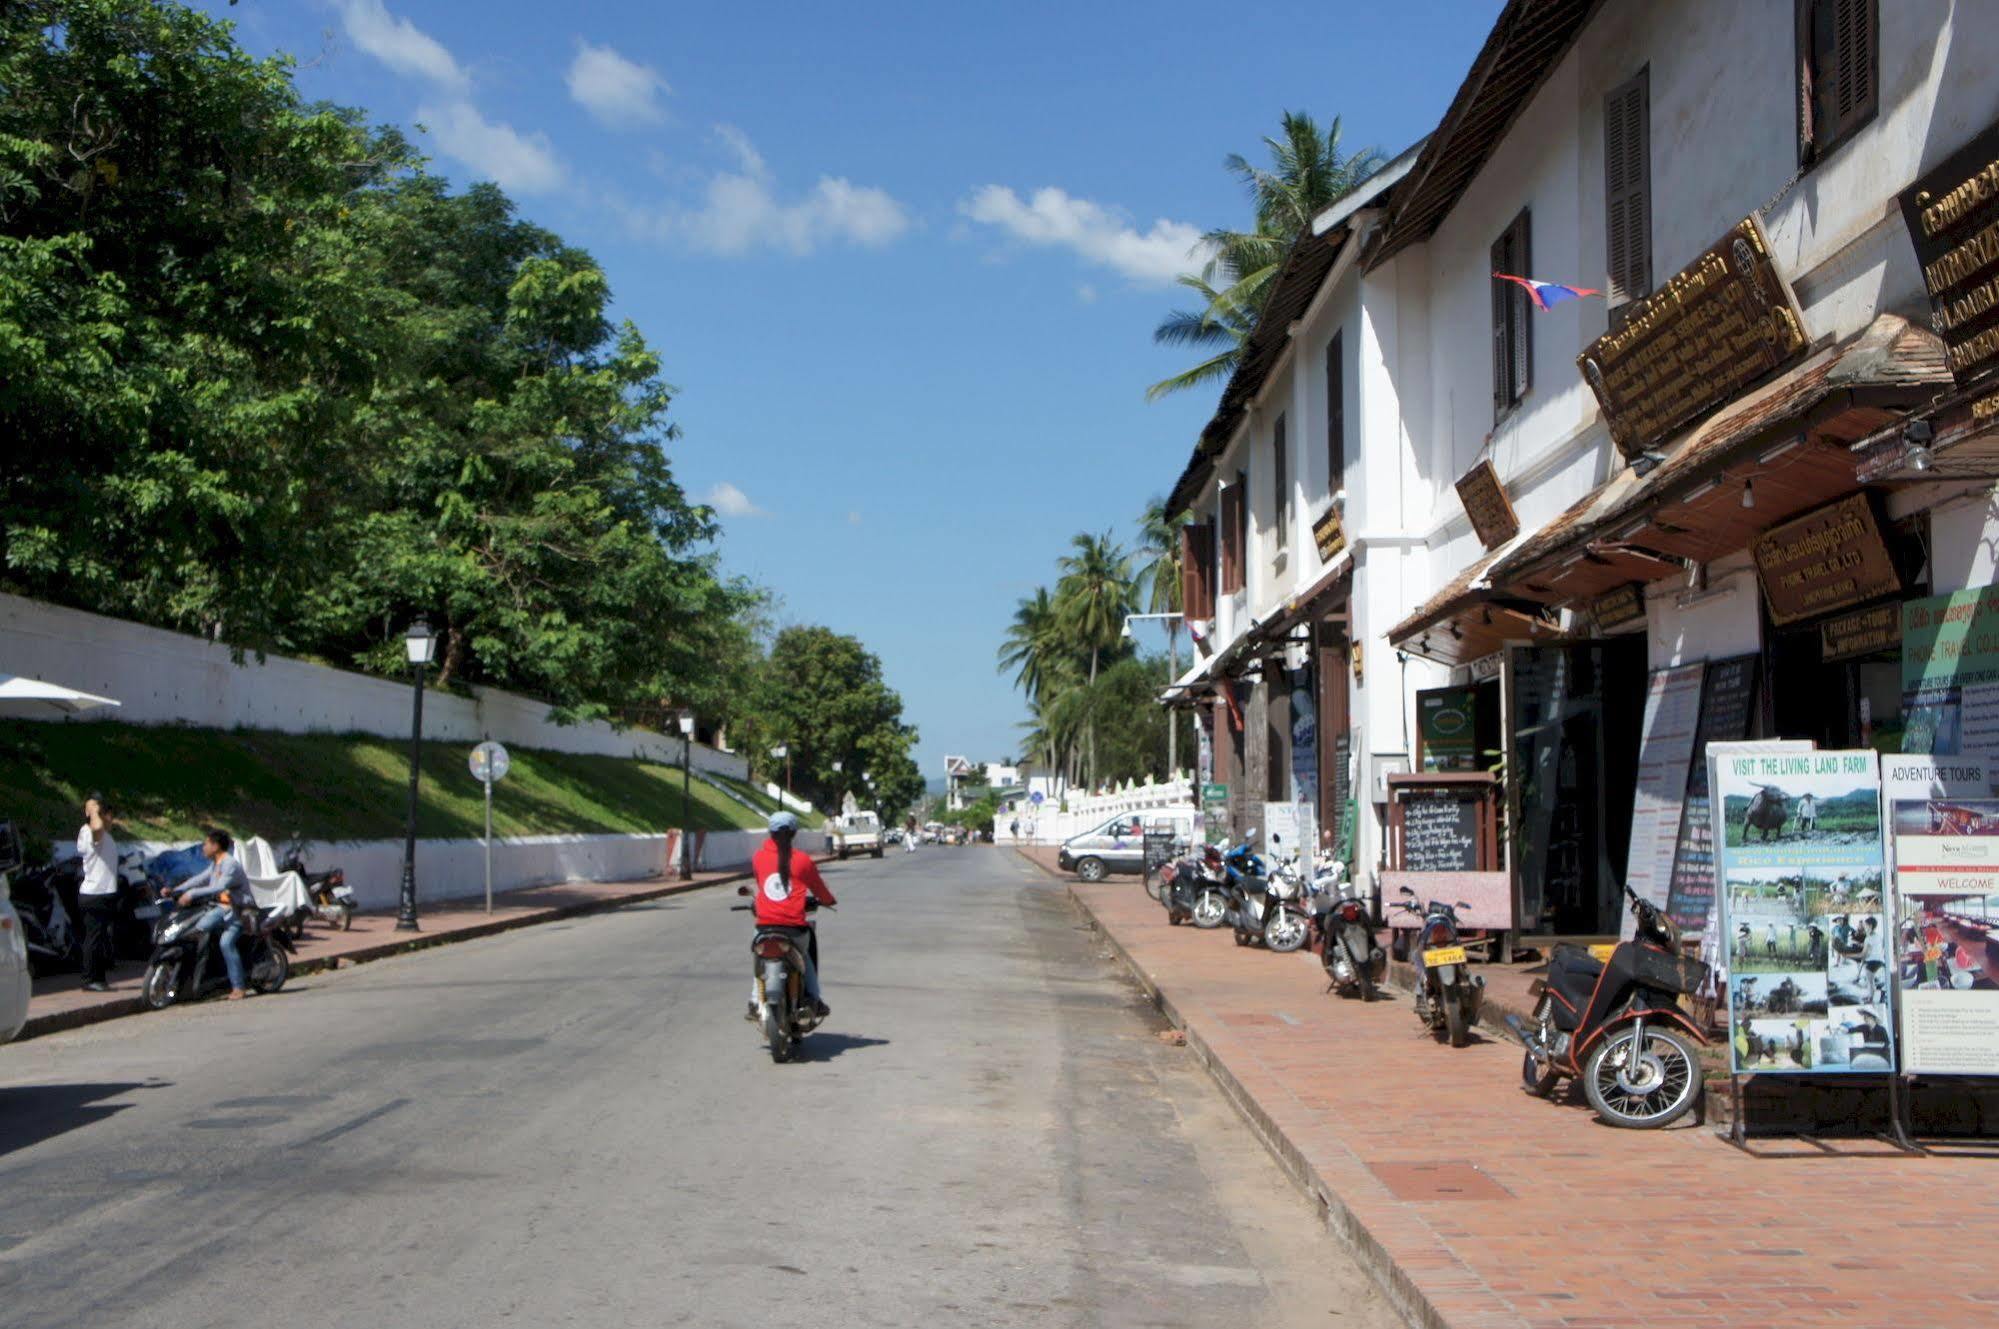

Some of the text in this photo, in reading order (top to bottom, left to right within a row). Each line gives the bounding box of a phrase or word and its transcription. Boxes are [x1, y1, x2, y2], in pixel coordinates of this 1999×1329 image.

[1732, 756, 1867, 776] VISIT THE LIVING LAND FARM
[1892, 766, 1981, 782] ADVENTURE TOURS
[1937, 878, 1994, 889] WELCOME
